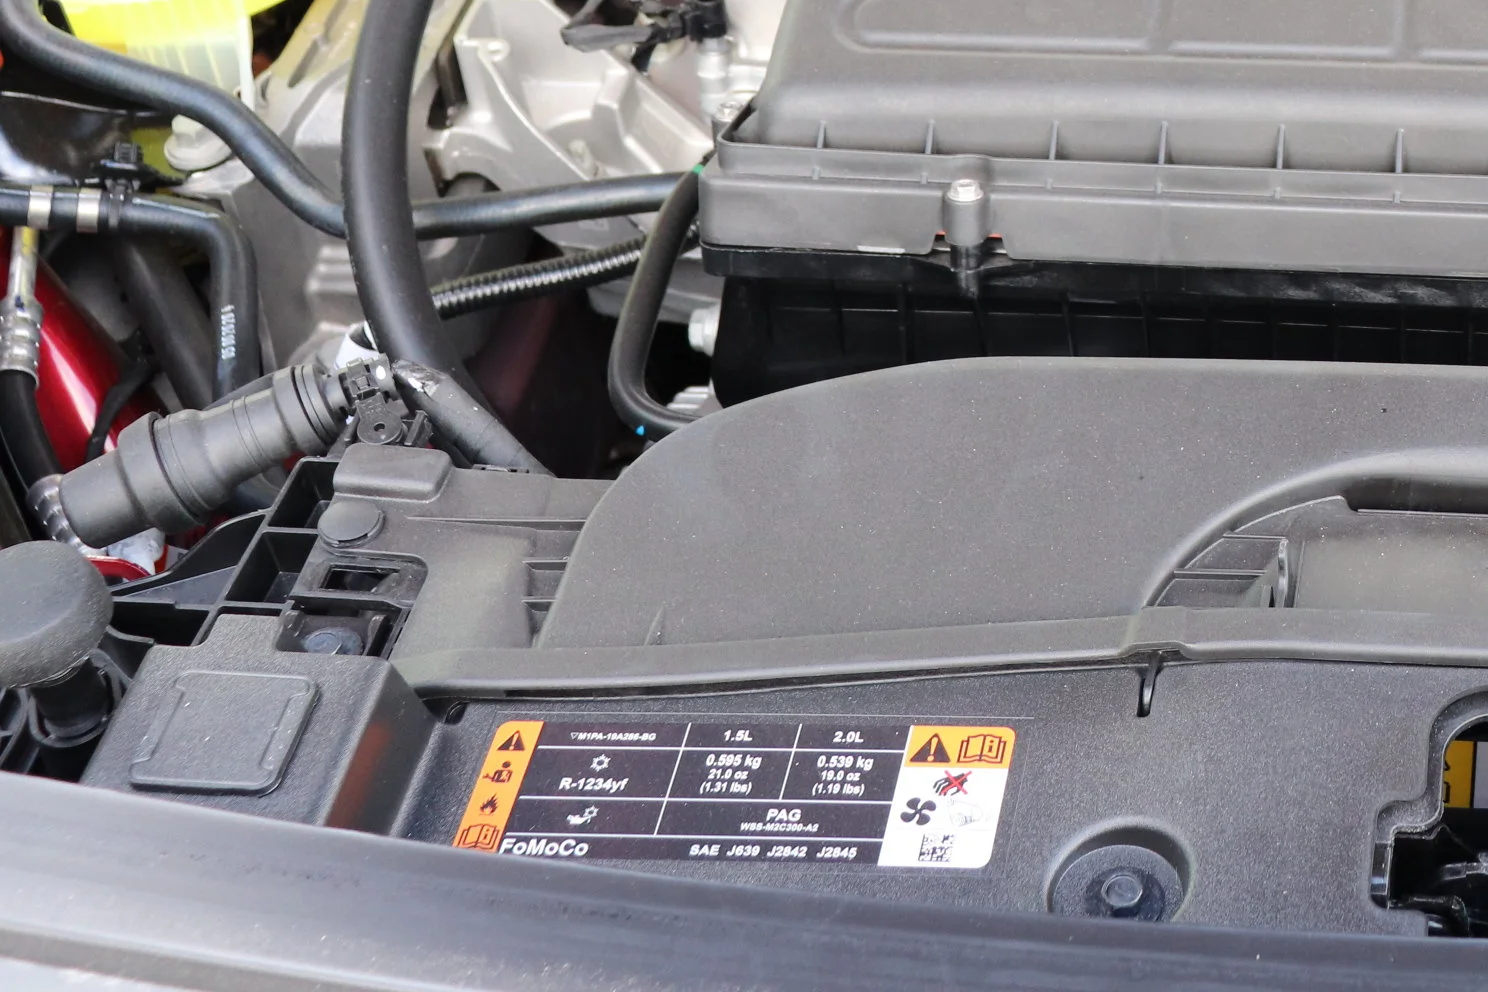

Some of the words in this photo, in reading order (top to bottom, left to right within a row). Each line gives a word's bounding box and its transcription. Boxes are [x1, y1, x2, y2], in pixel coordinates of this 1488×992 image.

[723, 729, 753, 742] 1.5L
[832, 730, 864, 744] 2.0L
[705, 753, 742, 767] 0.595
[743, 754, 762, 770] kg
[816, 755, 853, 768] 0.539
[855, 756, 874, 771] kg
[707, 768, 732, 780] 21.0
[733, 770, 749, 780] oz
[820, 769, 844, 781] 19.0
[845, 771, 861, 781] oz
[558, 777, 629, 793] R-1234yf
[699, 782, 727, 794] (1.31
[729, 781, 752, 795] lbs)
[811, 783, 840, 795] (1.19
[841, 783, 865, 796] lbs)
[766, 808, 802, 822] PAG
[499, 838, 590, 856] FoMoCo
[689, 843, 721, 856] SAE
[726, 844, 761, 857] J639
[766, 845, 808, 858] J2842
[816, 846, 858, 859] J2845
